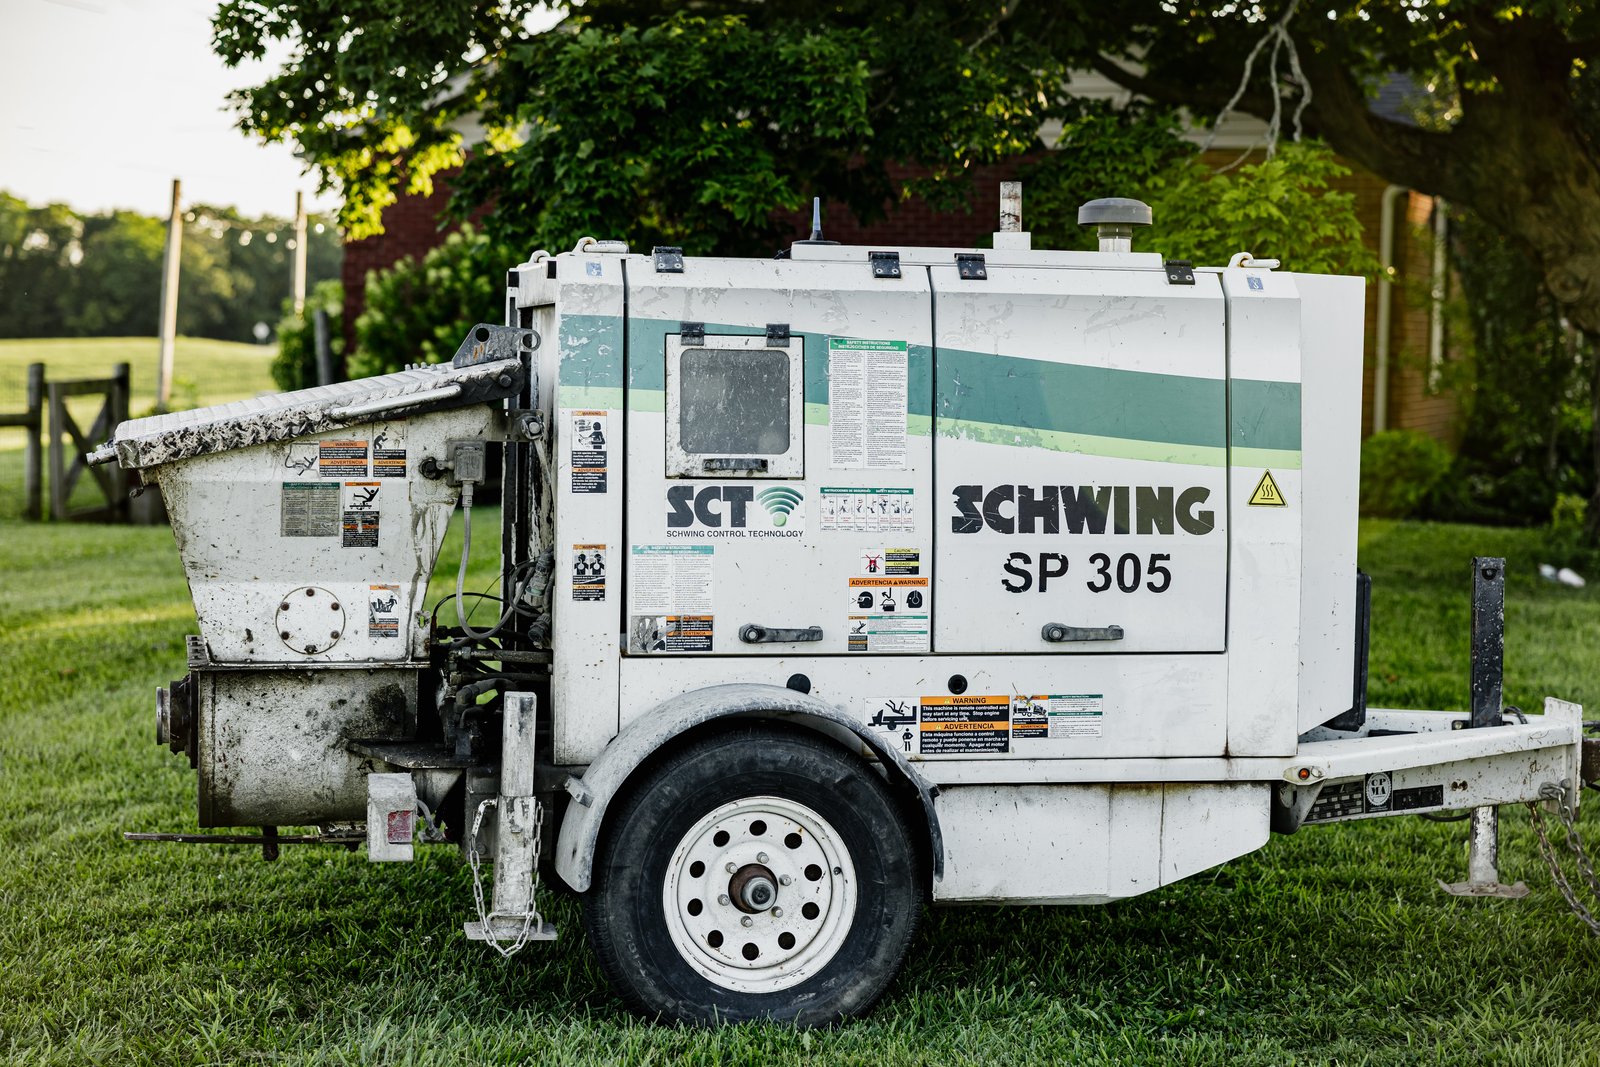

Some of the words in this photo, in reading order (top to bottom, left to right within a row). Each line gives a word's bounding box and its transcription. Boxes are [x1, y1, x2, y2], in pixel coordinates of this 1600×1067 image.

[667, 486, 754, 528] SCT
[952, 485, 1215, 535] SCHWING
[1001, 552, 1069, 594] SP
[1087, 553, 1171, 593] 305
